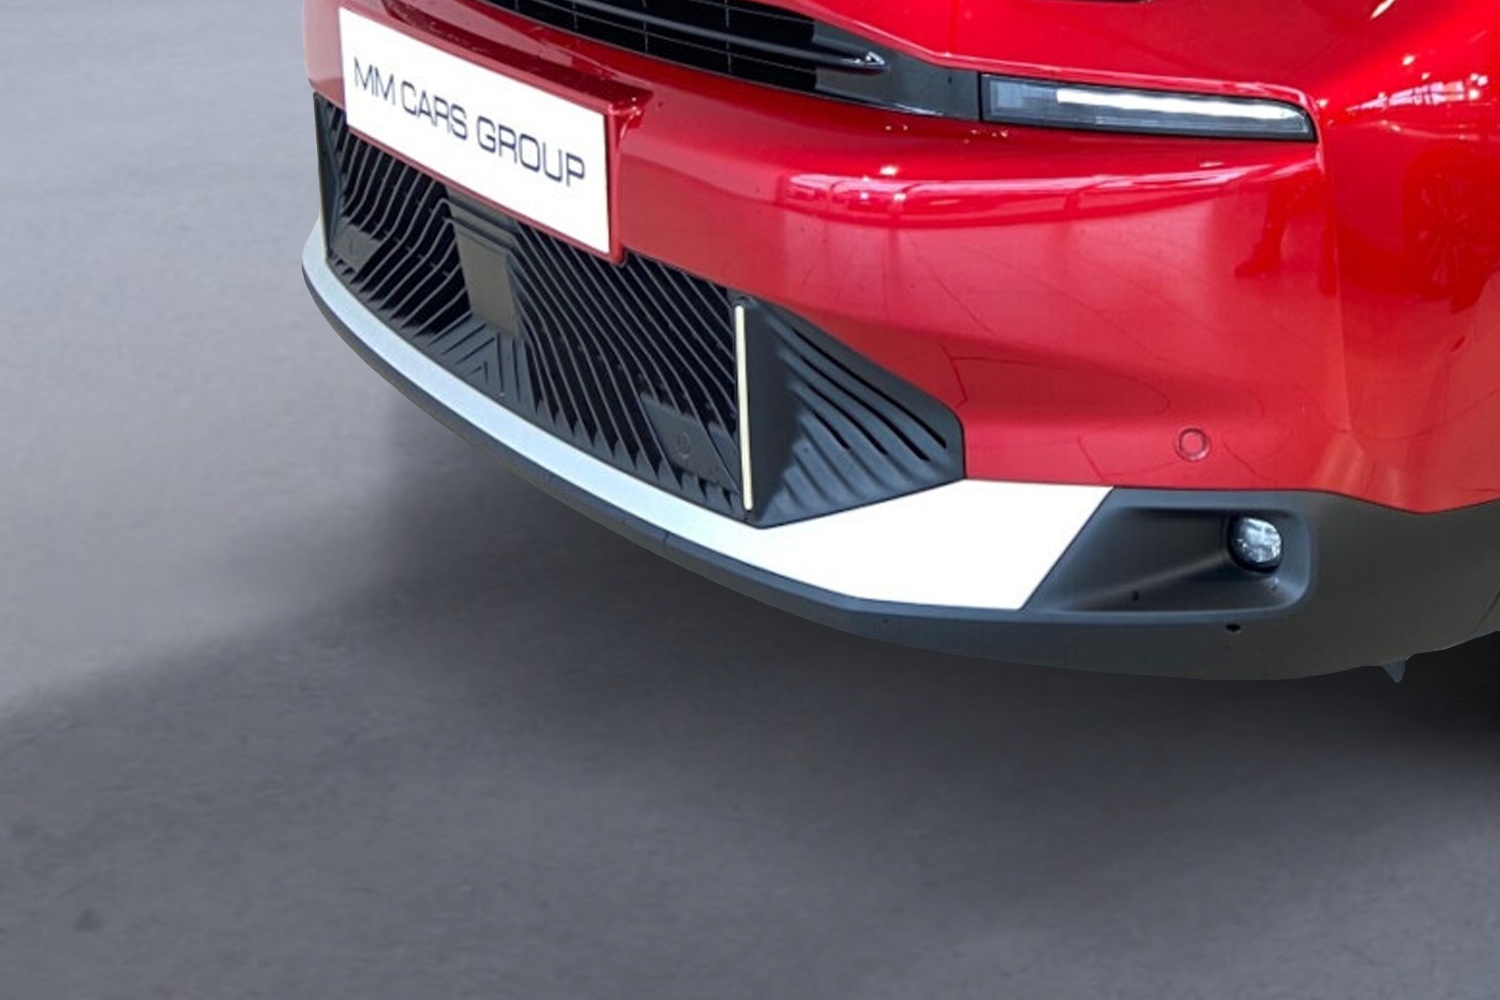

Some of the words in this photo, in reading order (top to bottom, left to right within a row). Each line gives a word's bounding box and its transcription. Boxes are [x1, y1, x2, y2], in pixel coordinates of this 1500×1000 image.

[353, 56, 396, 106] MM
[400, 80, 469, 142] CARS
[476, 115, 586, 188] GROUP
